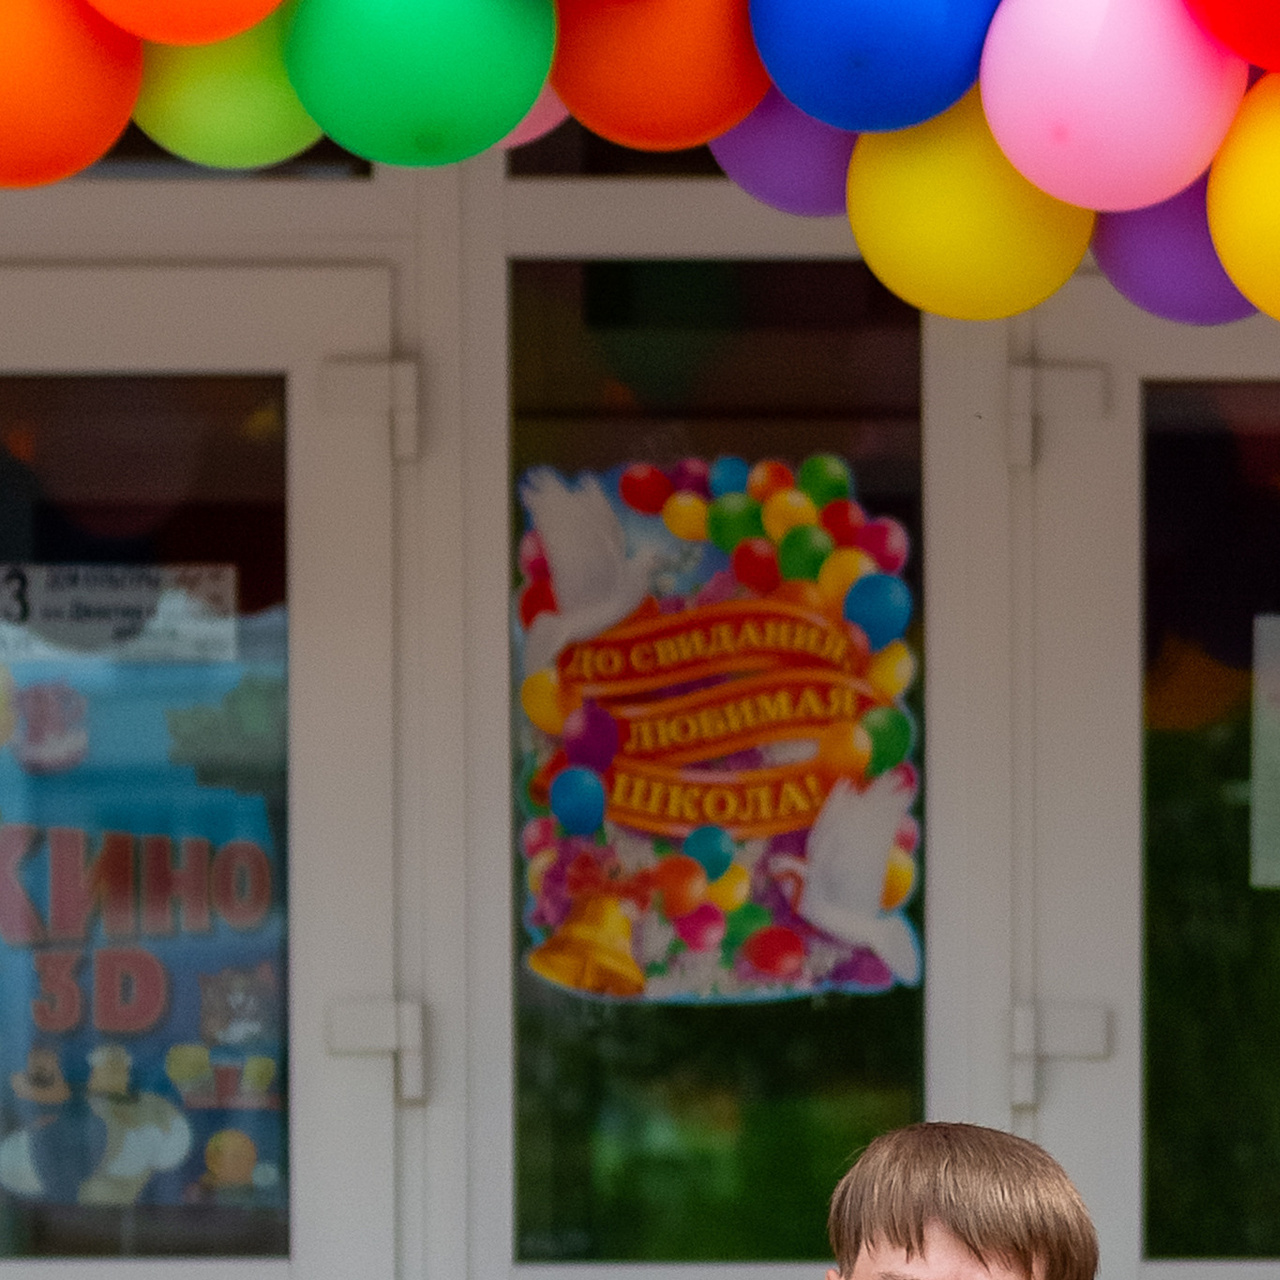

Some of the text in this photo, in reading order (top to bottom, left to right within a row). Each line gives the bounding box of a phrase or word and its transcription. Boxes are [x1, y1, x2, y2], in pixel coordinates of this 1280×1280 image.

[624, 686, 857, 751] ЛЮБИМАЯ
[612, 772, 821, 822] ШКОЛА!
[31, 936, 168, 1034] 3D
